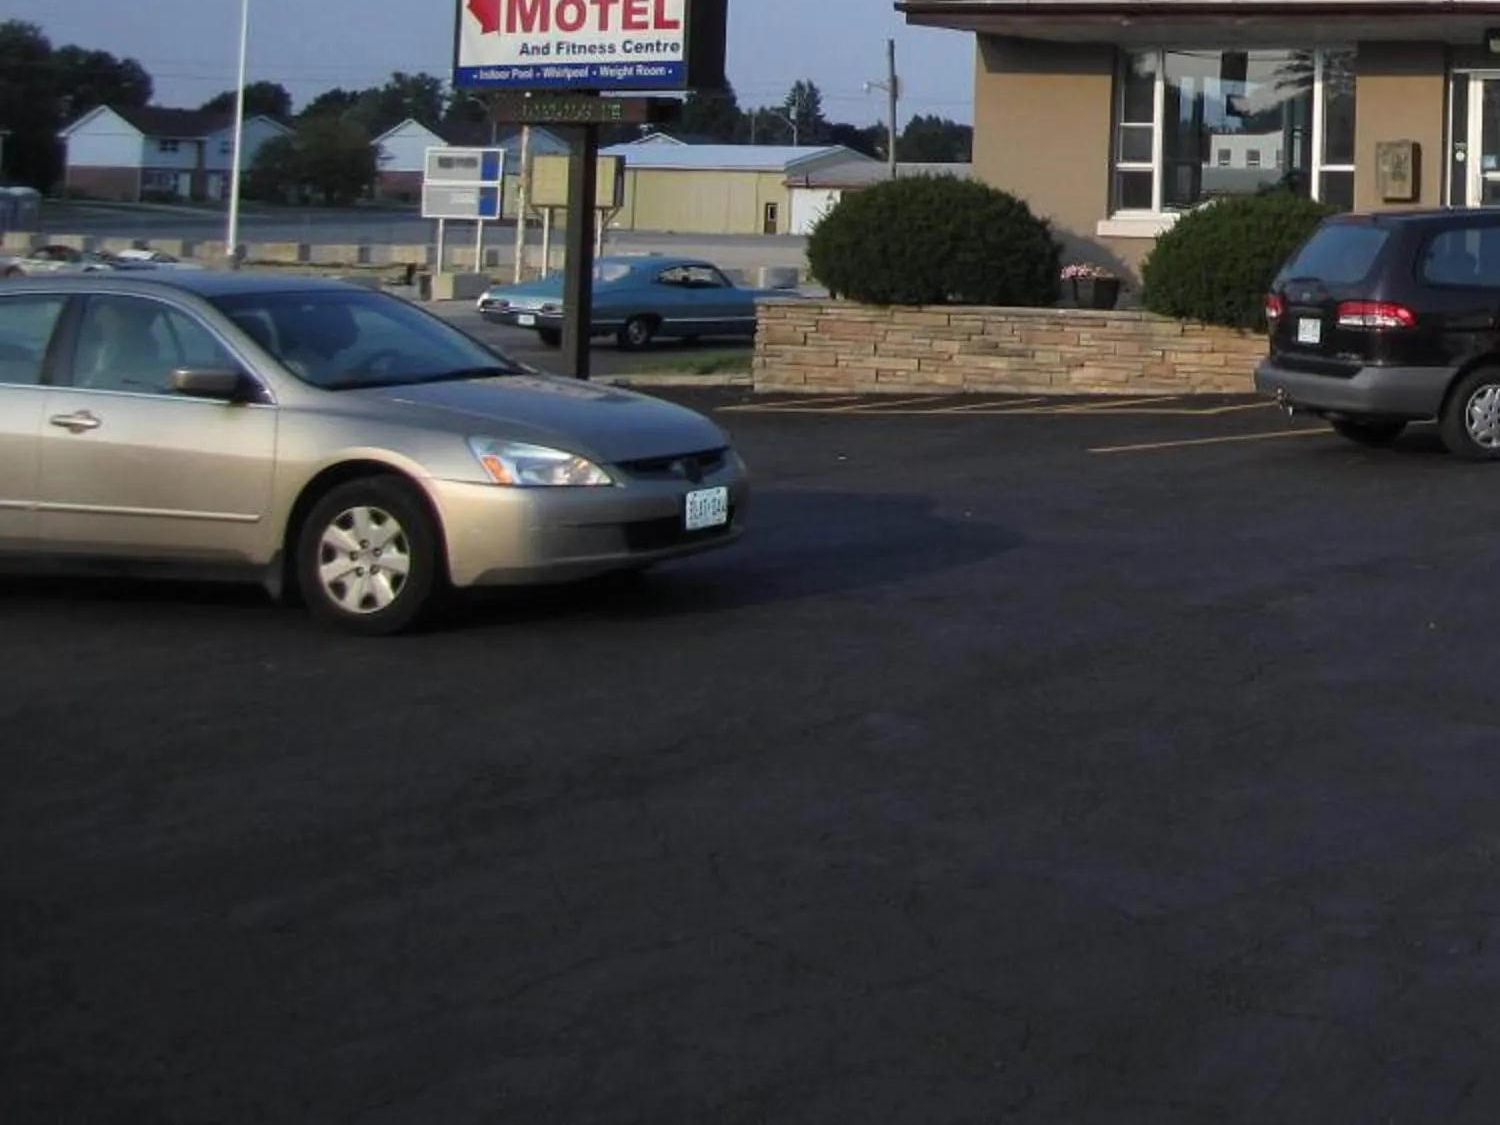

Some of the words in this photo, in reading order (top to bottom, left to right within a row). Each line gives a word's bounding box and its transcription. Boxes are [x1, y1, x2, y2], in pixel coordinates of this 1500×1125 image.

[519, 41, 551, 56] And
[555, 40, 617, 56] Fitness
[621, 38, 681, 54] Centre
[479, 68, 510, 80] Indoor
[511, 67, 535, 79] Pool
[599, 64, 634, 80] Weight
[635, 64, 666, 76] Room
